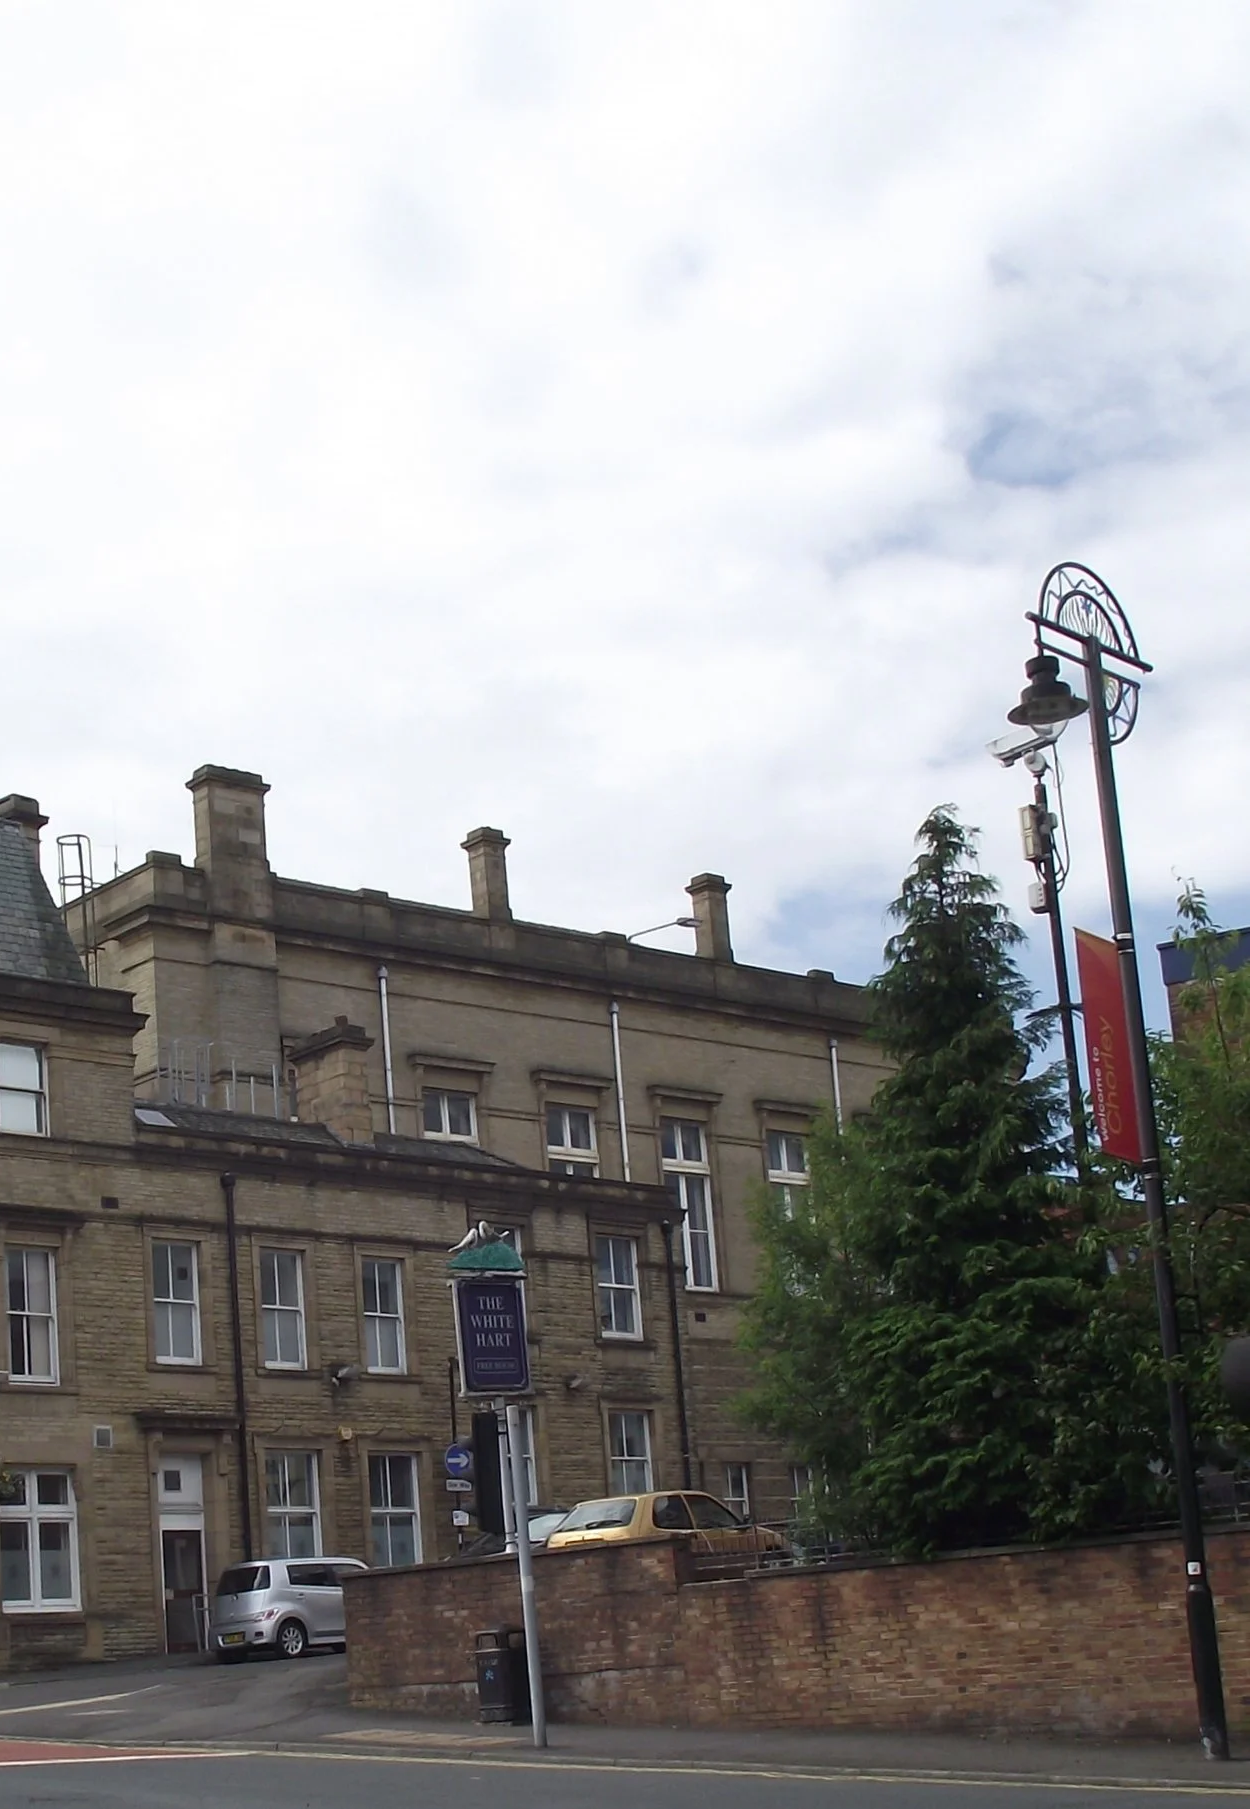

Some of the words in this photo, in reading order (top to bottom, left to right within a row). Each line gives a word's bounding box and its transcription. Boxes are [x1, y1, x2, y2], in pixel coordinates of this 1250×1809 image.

[1092, 1046, 1100, 1062] to
[1099, 1015, 1122, 1135] Chorley
[1094, 1067, 1109, 1141] welcome
[477, 1296, 504, 1310] THE
[470, 1315, 514, 1328] WHITE
[476, 1333, 512, 1347] HART
